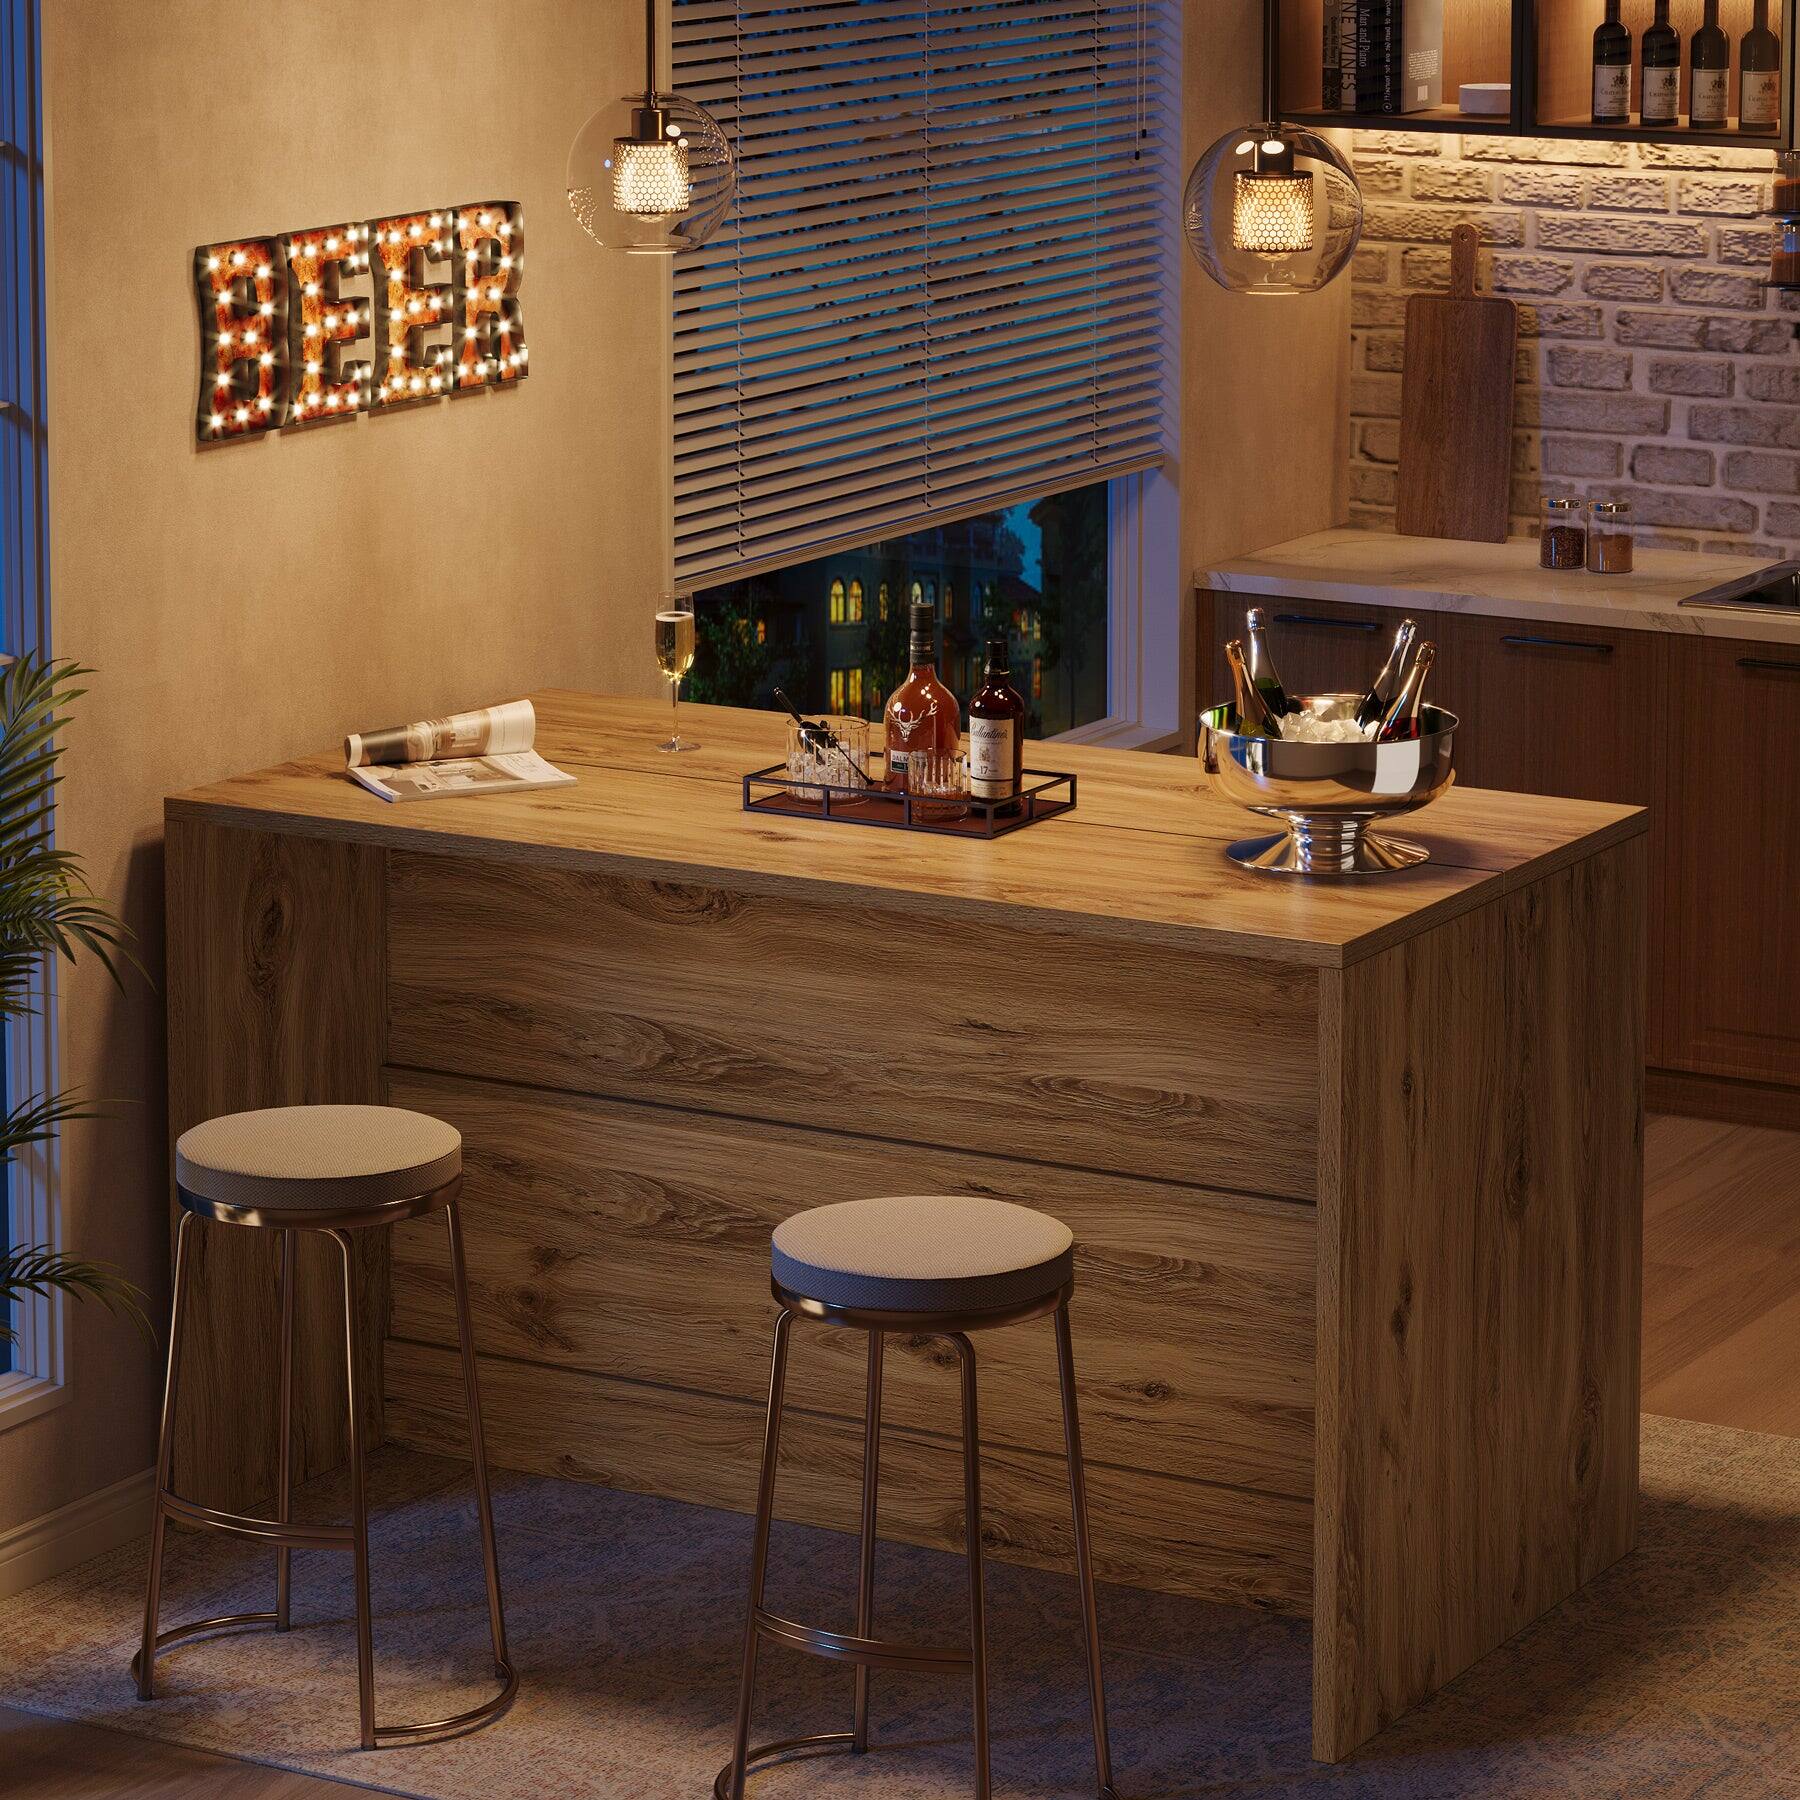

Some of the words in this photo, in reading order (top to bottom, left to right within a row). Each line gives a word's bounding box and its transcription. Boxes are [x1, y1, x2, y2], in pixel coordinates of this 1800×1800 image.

[1359, 8, 1370, 26] Man
[1359, 27, 1371, 43] and
[1341, 33, 1357, 90] WINES
[1359, 45, 1370, 68] Piano
[193, 200, 529, 442] BEER
[980, 766, 989, 775] 17
